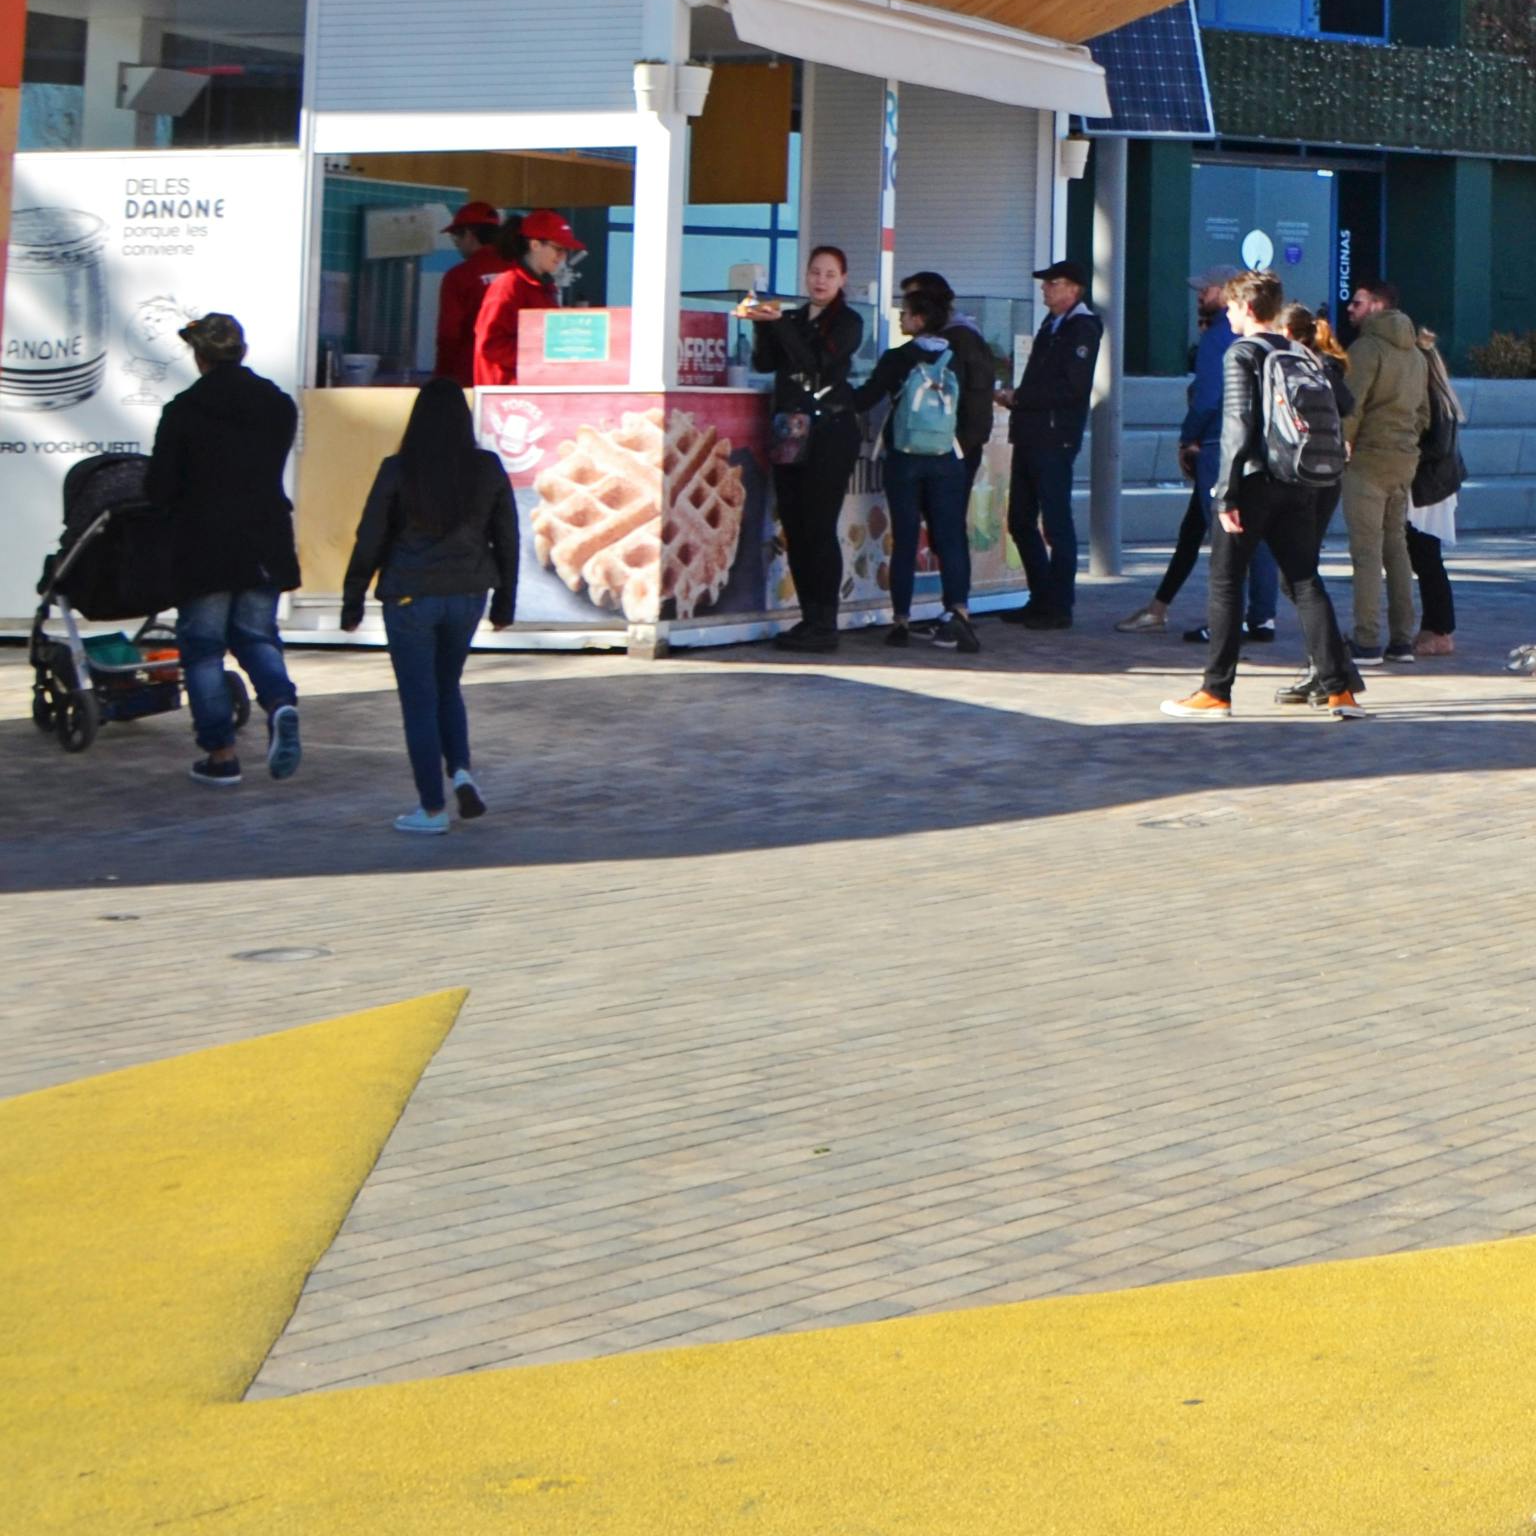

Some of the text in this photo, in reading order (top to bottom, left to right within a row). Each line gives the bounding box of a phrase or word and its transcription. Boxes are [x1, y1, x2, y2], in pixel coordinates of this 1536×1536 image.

[125, 177, 191, 196] DELES
[125, 198, 226, 219] DANONE
[123, 223, 208, 241] porque les
[121, 244, 195, 256] conviene
[1339, 228, 1351, 301] OFICINAS
[8, 335, 82, 360] ANONE
